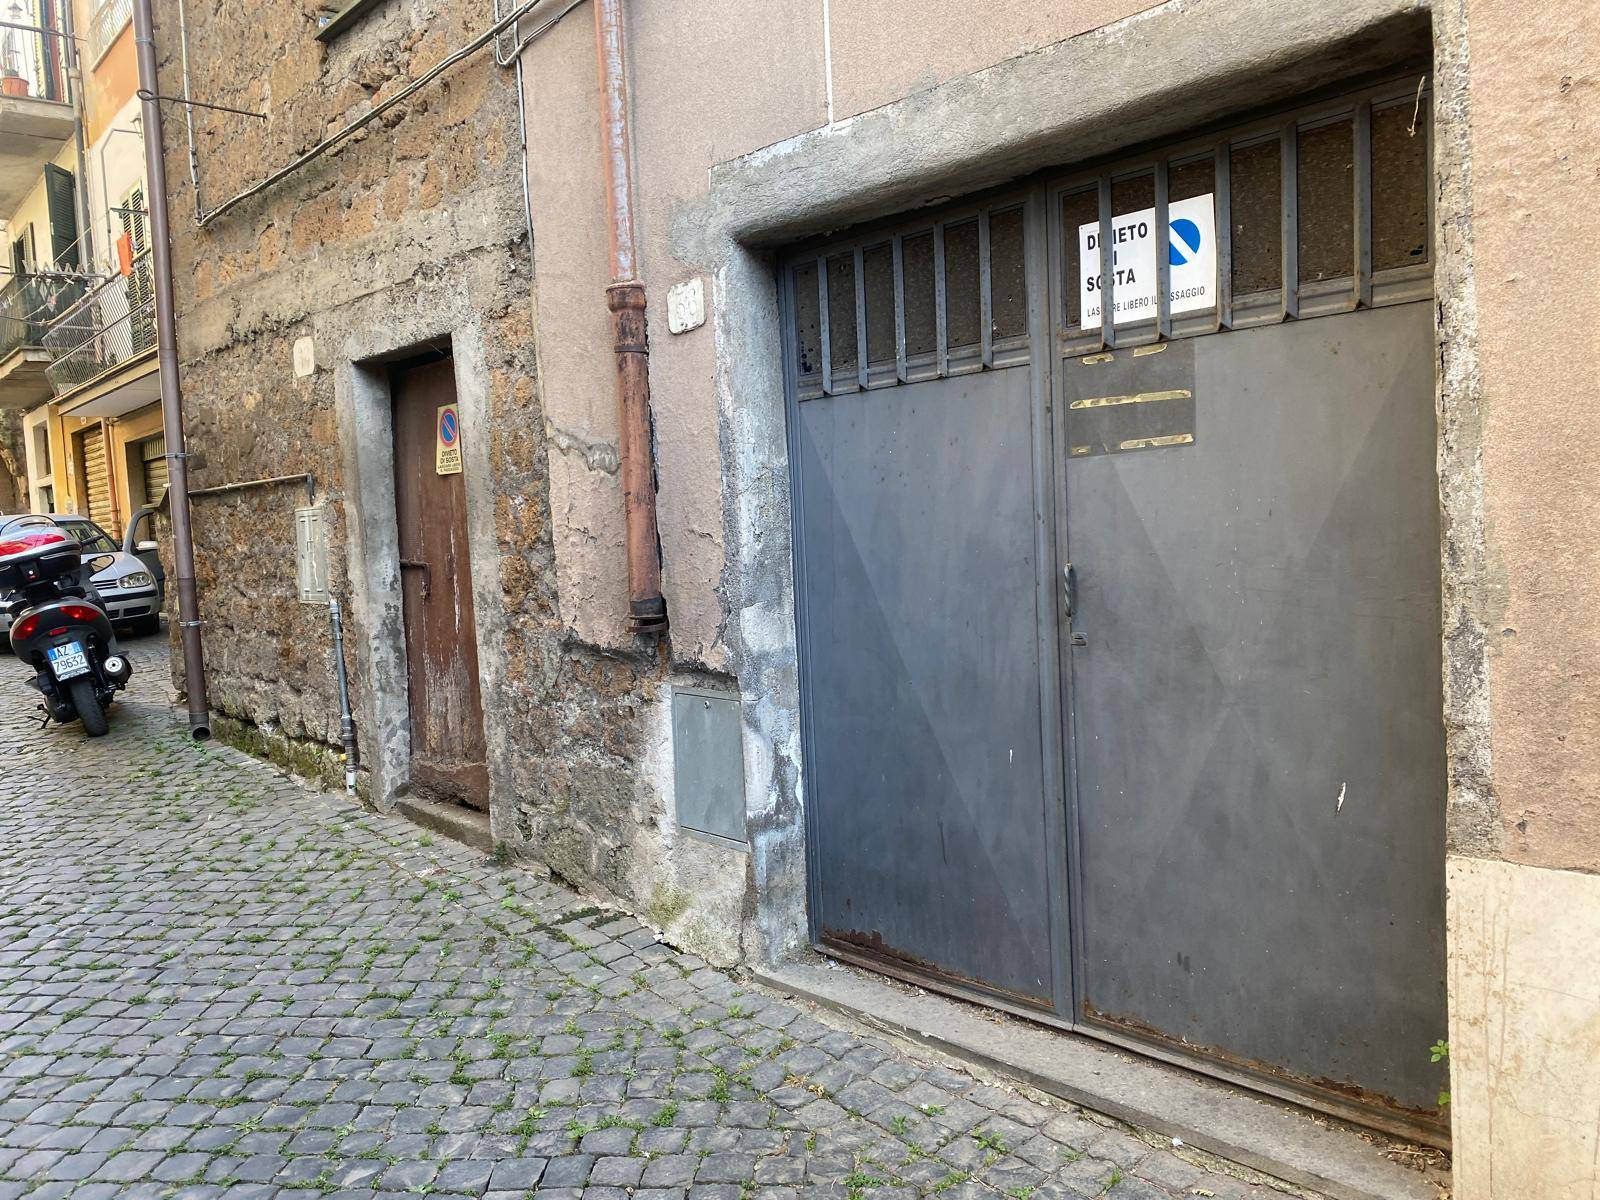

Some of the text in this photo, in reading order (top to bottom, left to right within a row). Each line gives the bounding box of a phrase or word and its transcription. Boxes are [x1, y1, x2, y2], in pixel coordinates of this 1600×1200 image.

[1087, 222, 1148, 250] DIIETO
[1087, 268, 1136, 292] SOTA
[1087, 302, 1121, 317] LASRE
[1123, 296, 1149, 311] LIBERO
[1169, 286, 1205, 301] SSAGGIO
[57, 645, 68, 657] AZ
[53, 655, 85, 672] 79632
